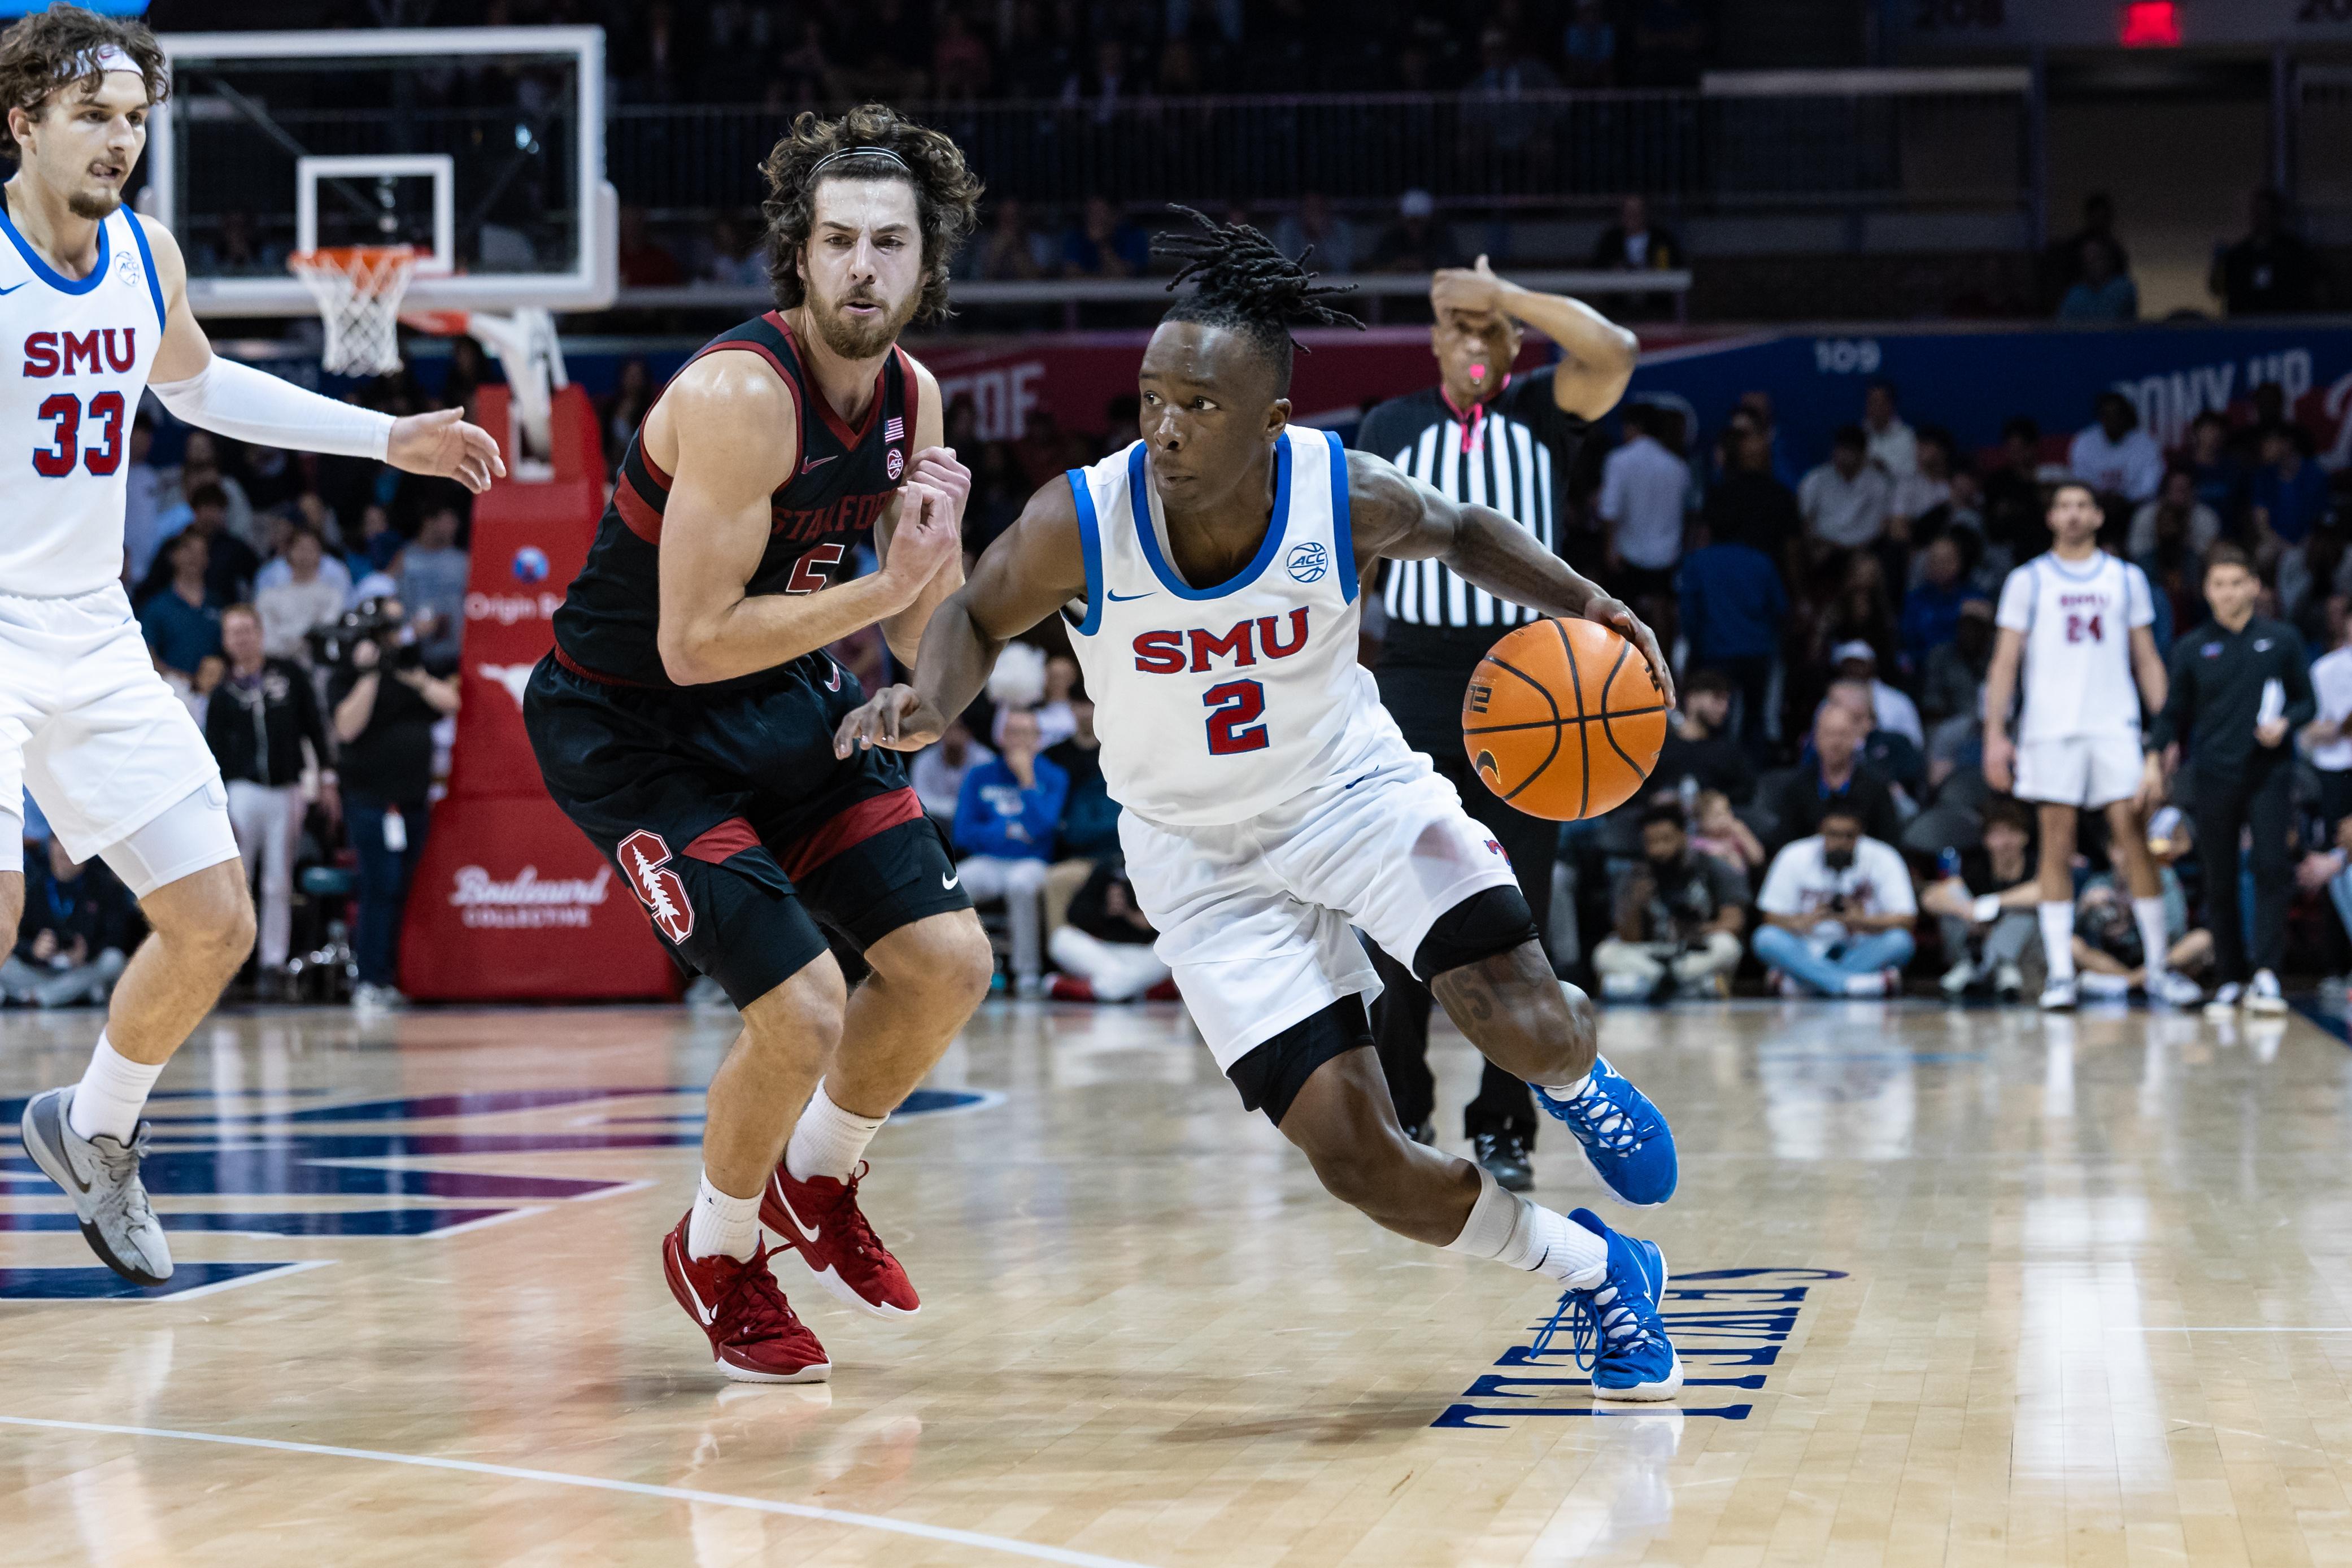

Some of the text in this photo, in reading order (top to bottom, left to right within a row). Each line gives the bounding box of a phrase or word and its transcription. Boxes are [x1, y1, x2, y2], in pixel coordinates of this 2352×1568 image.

[23, 328, 136, 378] SMU
[32, 390, 125, 478] 33
[786, 543, 845, 595] 5
[1291, 551, 1326, 567] ACC
[464, 592, 537, 626] Origin
[1132, 606, 1310, 674] SMU
[1202, 678, 1270, 756] 2
